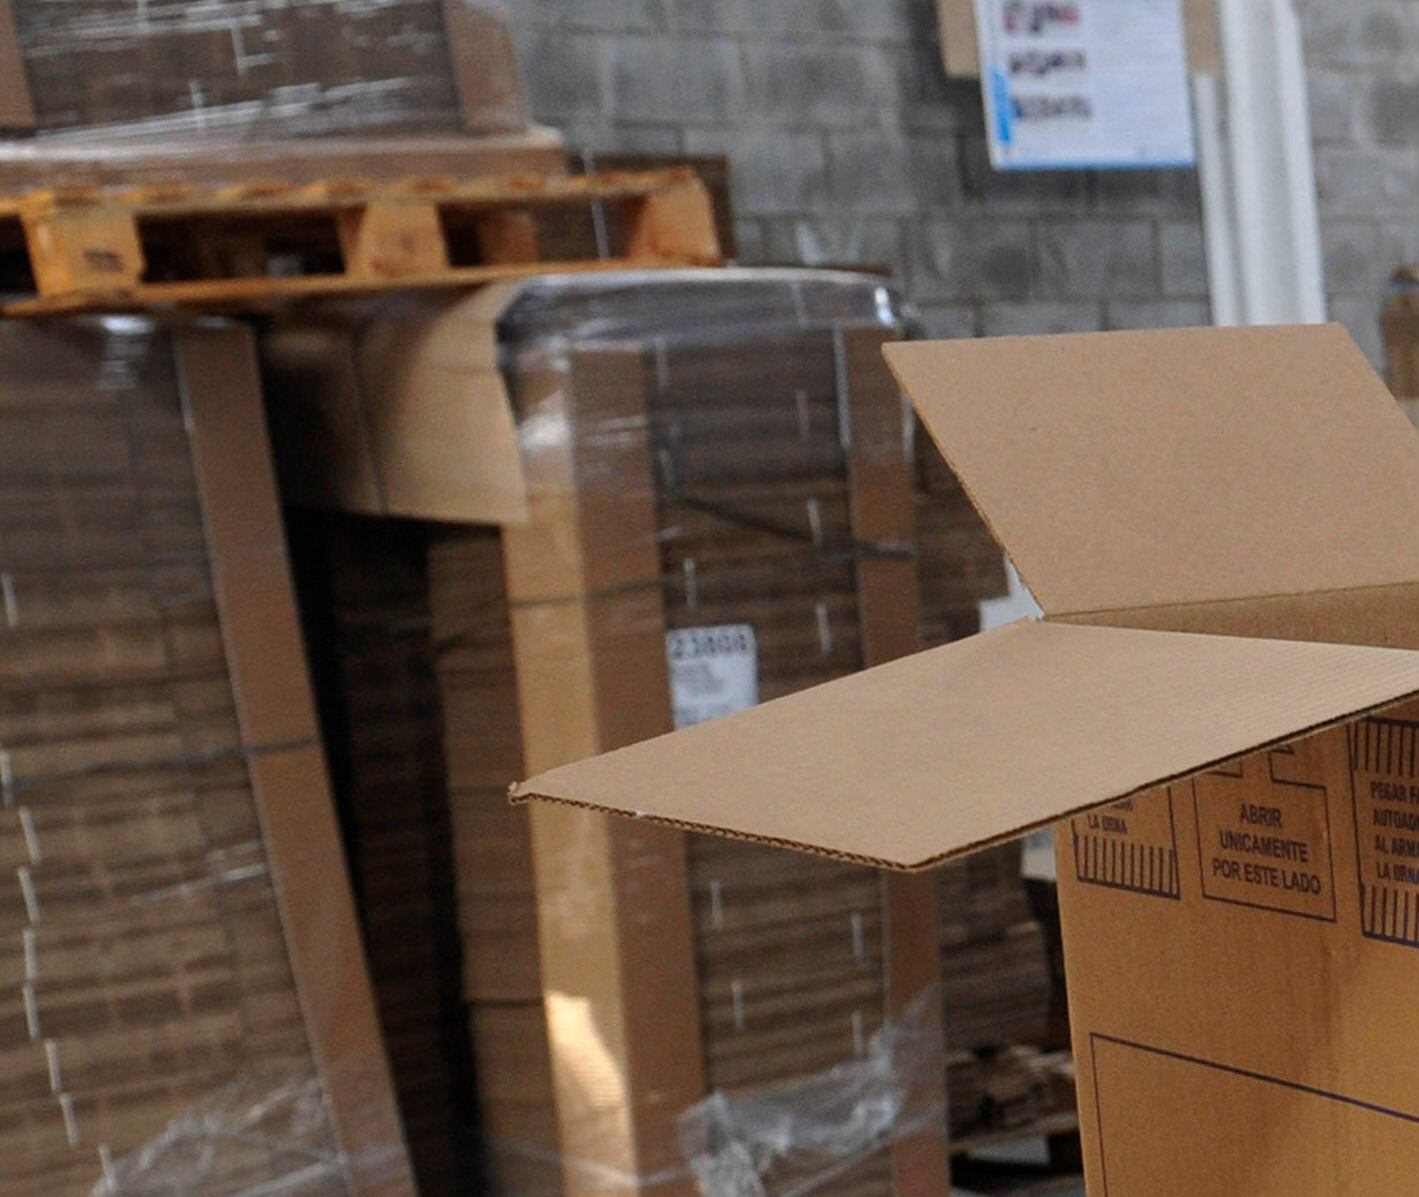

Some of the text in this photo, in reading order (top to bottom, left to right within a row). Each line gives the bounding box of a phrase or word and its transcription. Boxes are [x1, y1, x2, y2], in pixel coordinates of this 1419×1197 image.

[1240, 803, 1282, 828] ABRIR
[1219, 829, 1309, 863] UNICAMENTE
[1212, 857, 1321, 895] POR ESTE LADO
